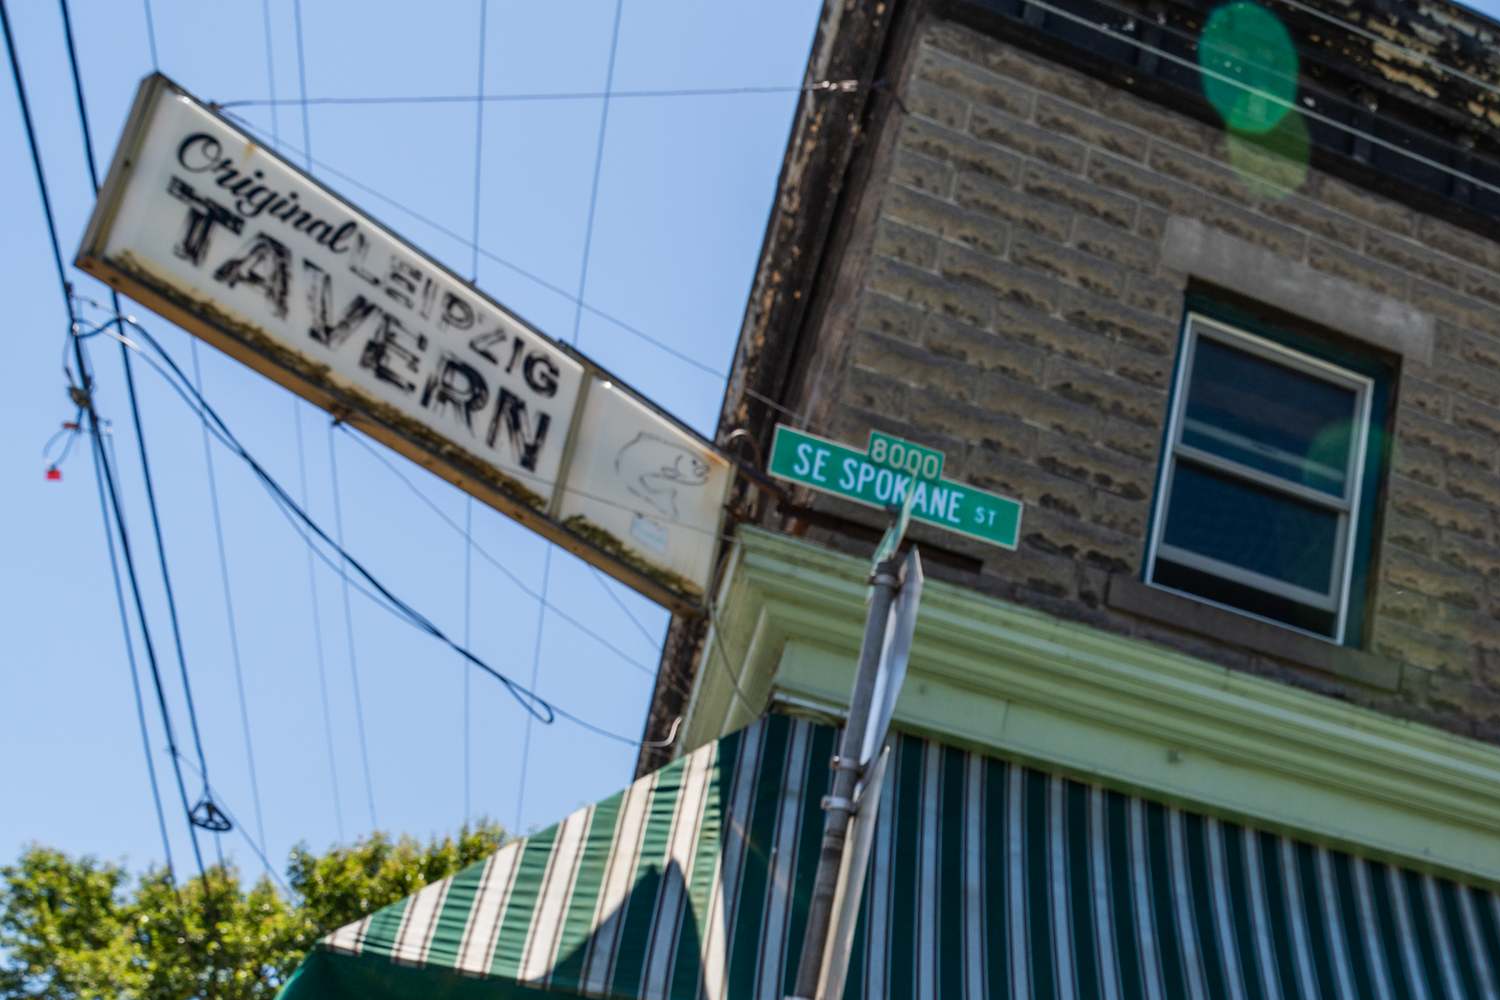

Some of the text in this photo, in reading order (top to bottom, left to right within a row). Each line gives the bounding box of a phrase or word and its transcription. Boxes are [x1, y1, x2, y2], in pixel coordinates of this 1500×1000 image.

[177, 132, 360, 254] Original
[167, 175, 551, 472] TAVERN
[794, 443, 997, 527] SE SPOKANE ST
[871, 439, 939, 479] 8000
